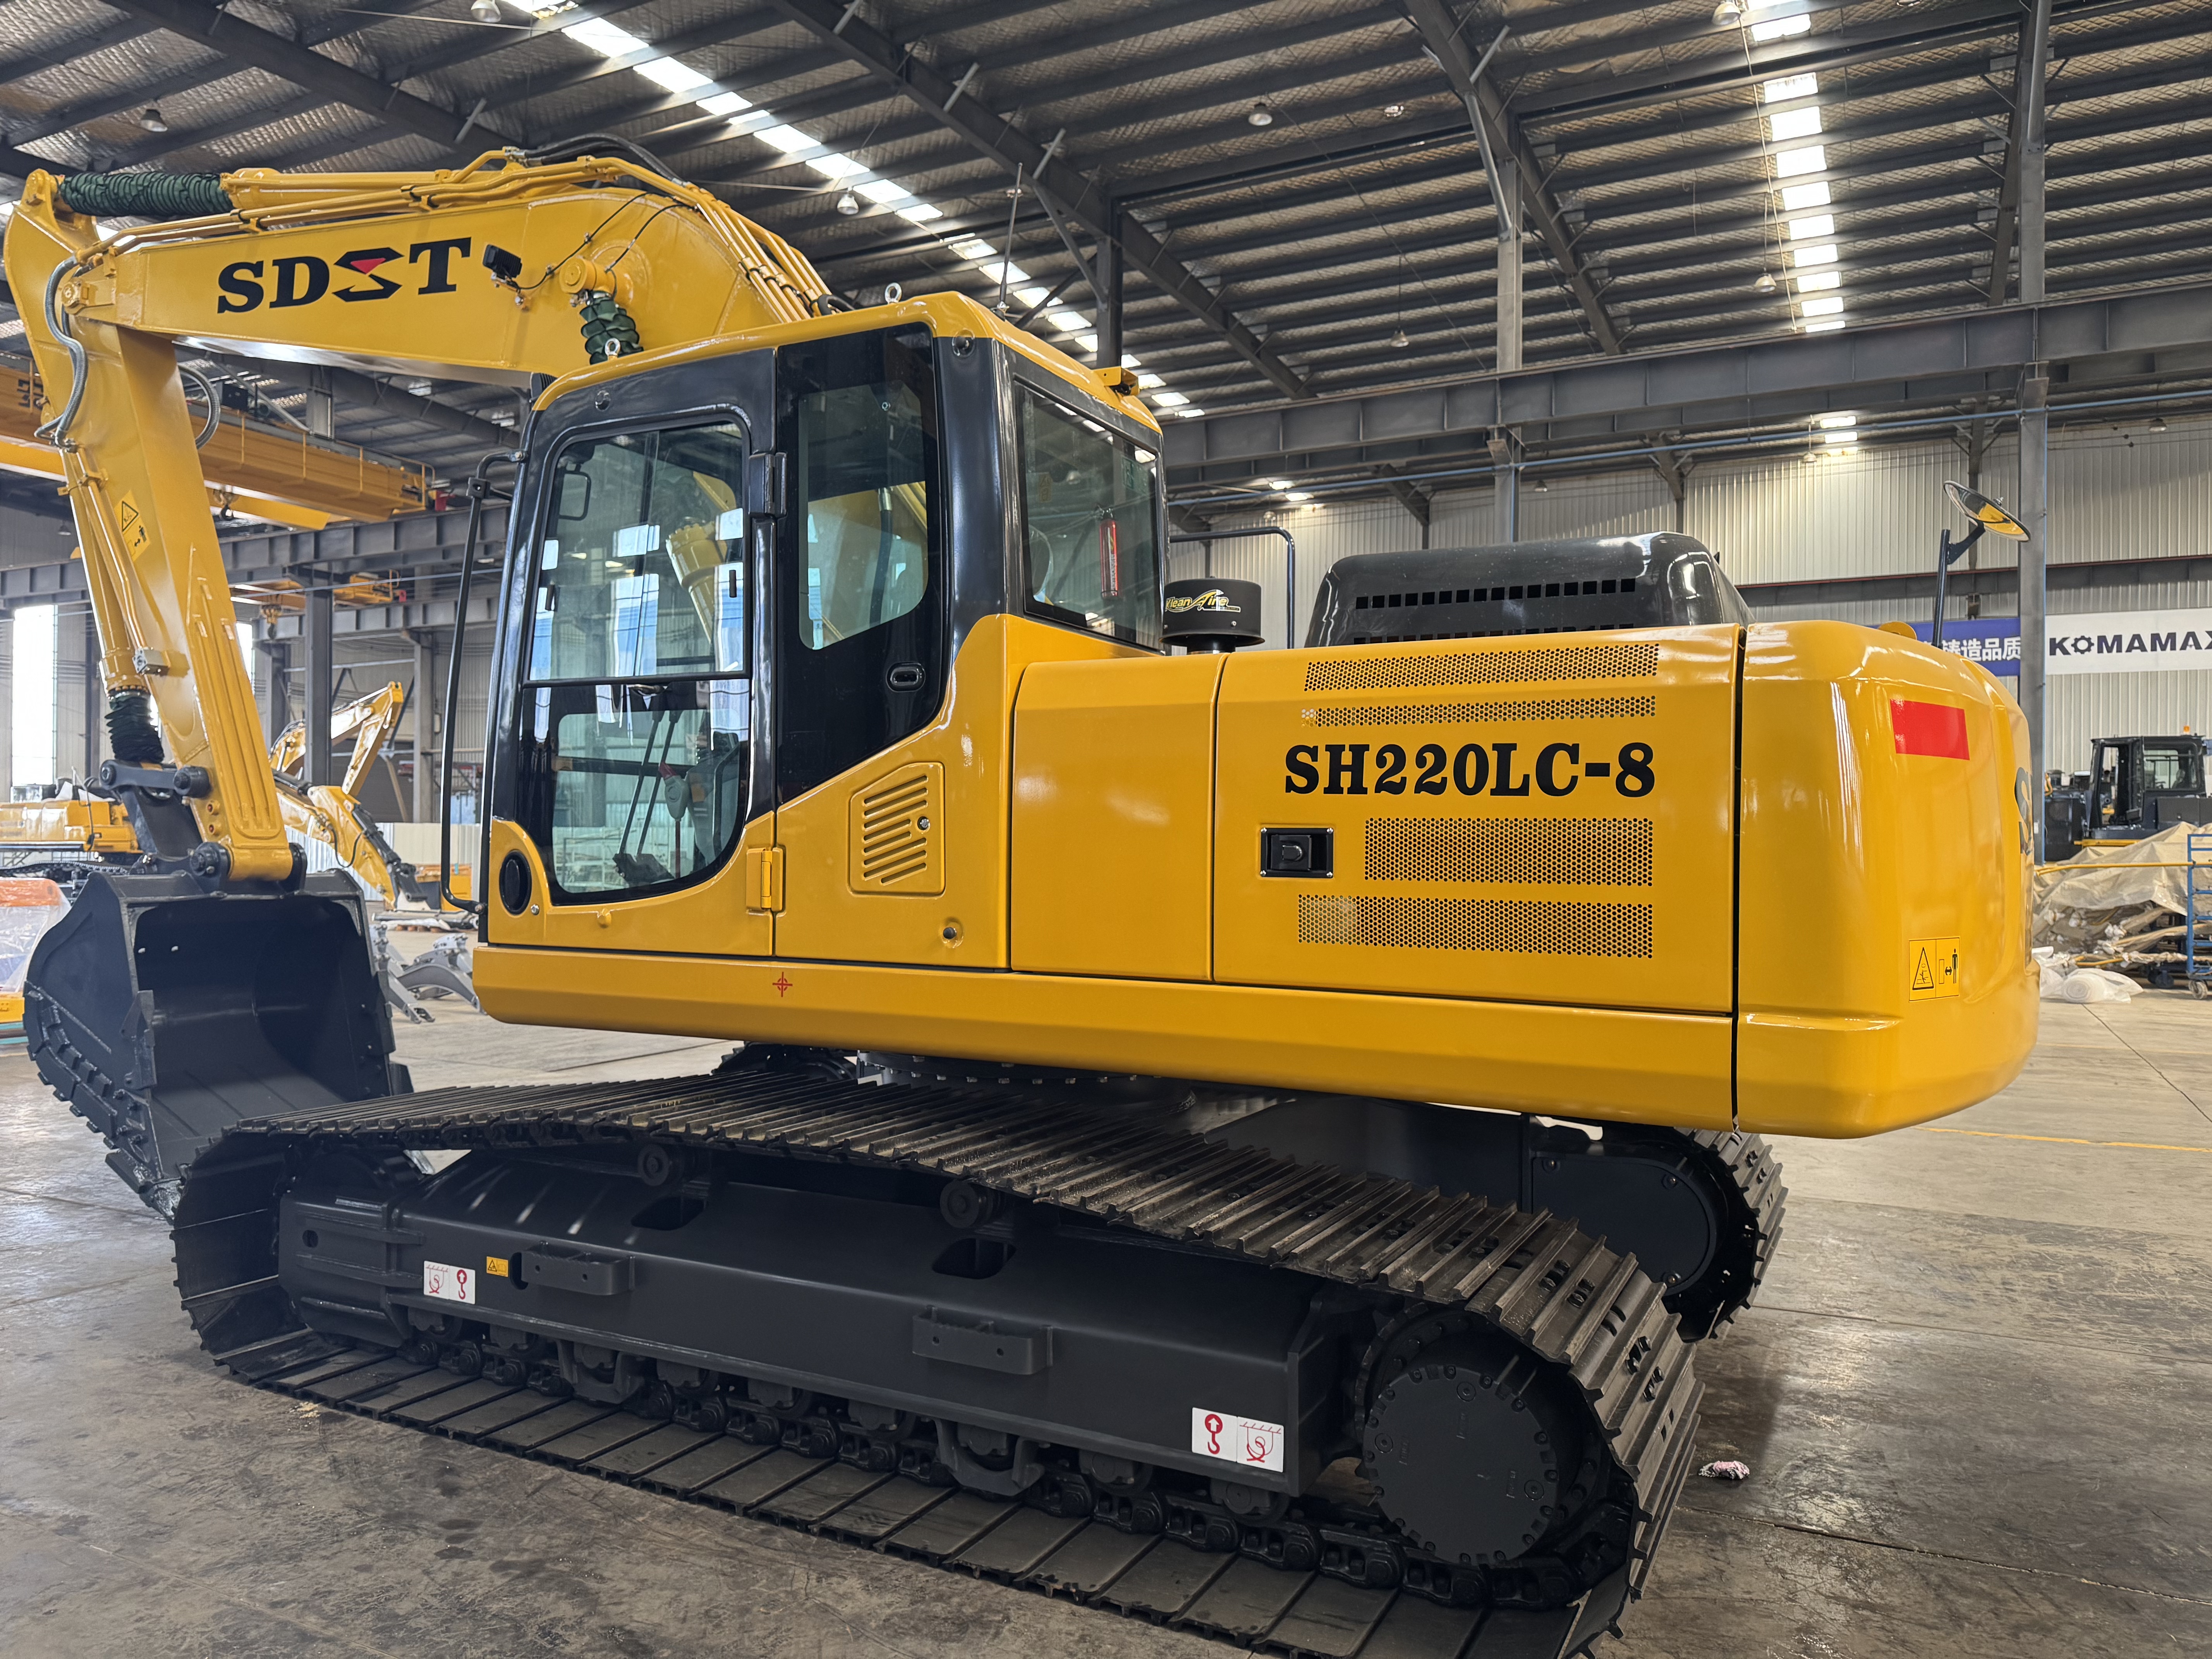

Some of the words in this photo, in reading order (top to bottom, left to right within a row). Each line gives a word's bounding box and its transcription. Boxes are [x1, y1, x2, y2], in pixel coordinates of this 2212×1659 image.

[1923, 636, 2021, 661] 铸造品质
[1285, 742, 1655, 798] SH220LC-8
